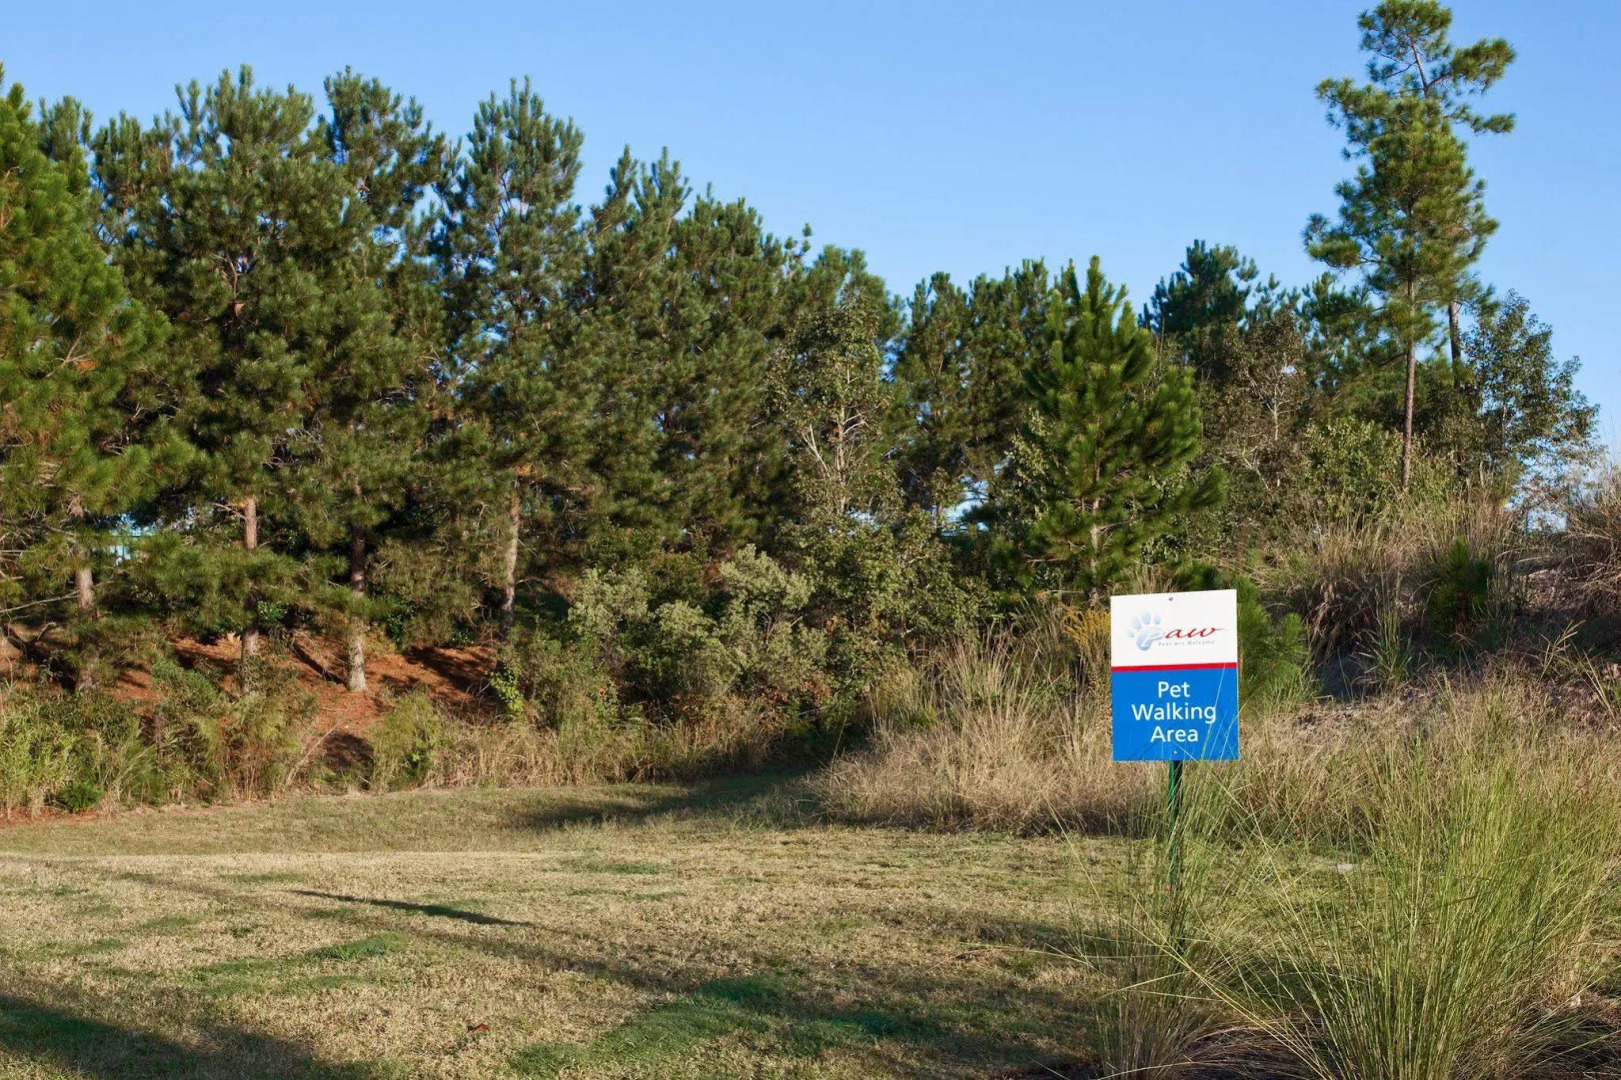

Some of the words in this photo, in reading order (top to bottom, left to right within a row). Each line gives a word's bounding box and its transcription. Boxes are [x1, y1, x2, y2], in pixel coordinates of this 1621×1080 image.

[1157, 681, 1191, 698] Pet
[1131, 702, 1217, 724] Walking
[1150, 727, 1199, 742] Area
